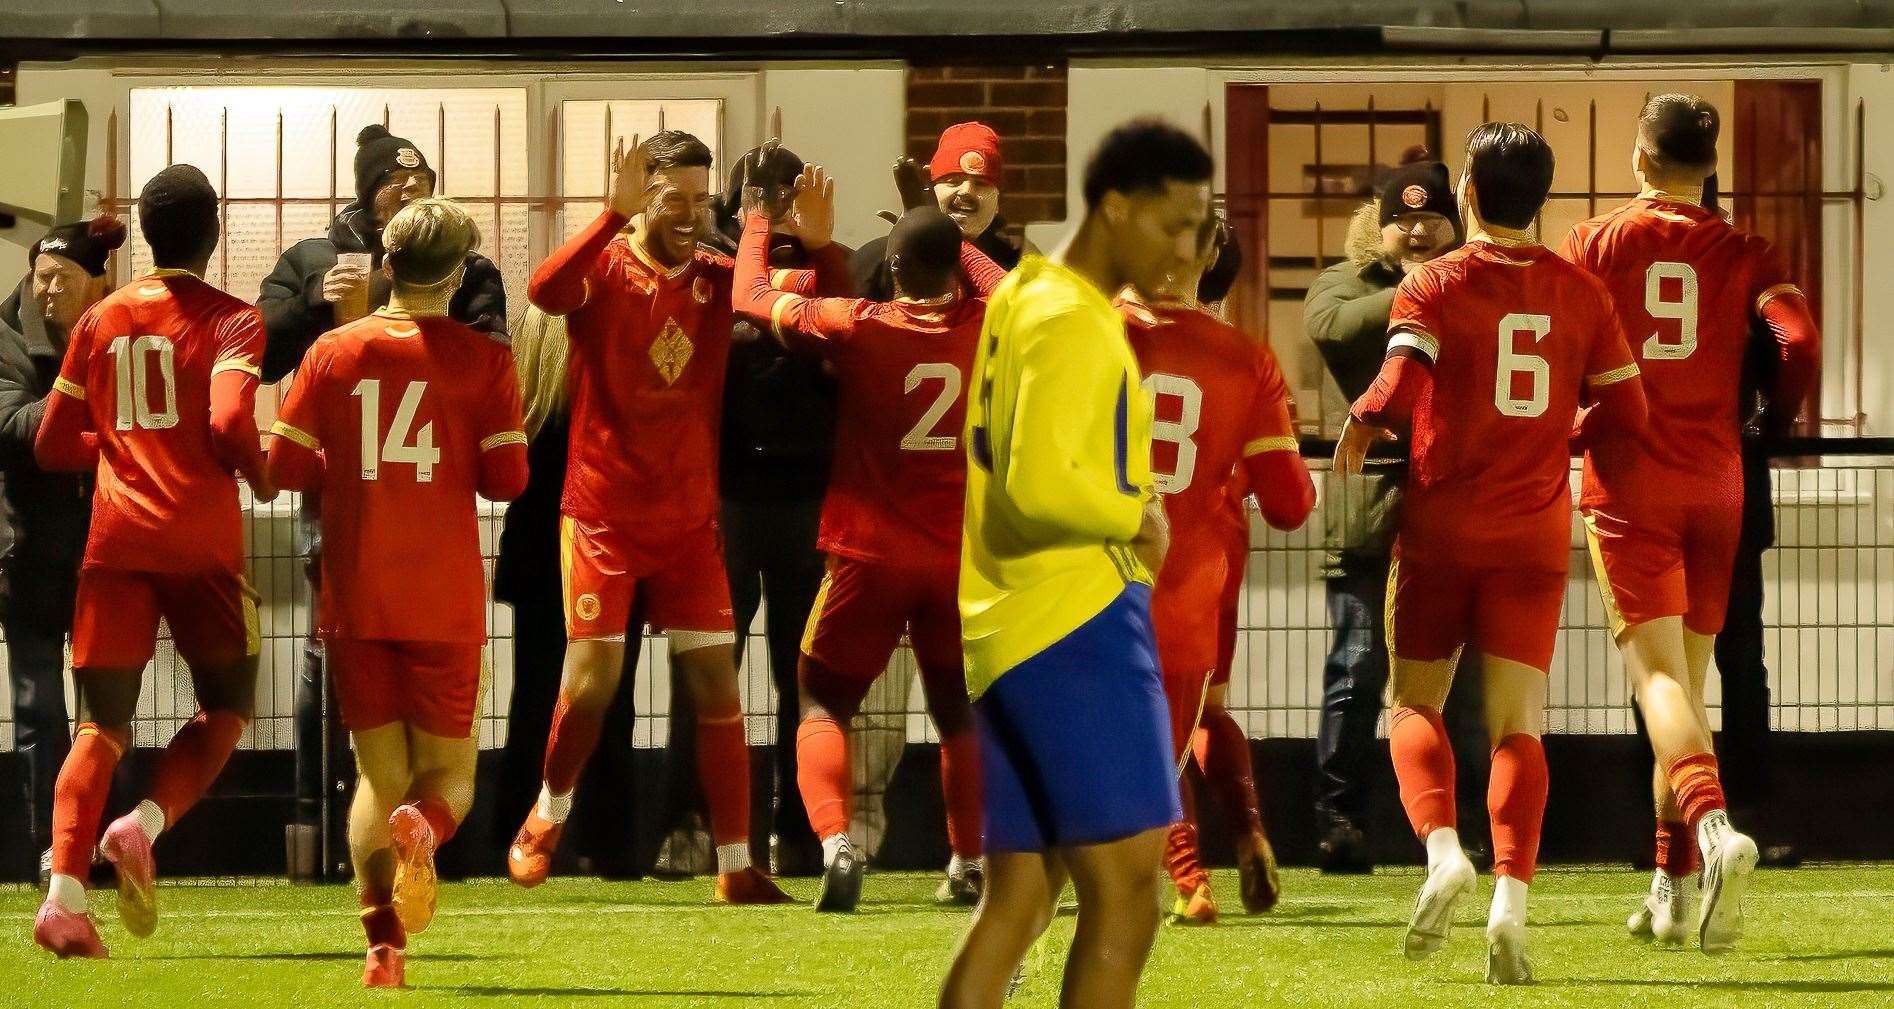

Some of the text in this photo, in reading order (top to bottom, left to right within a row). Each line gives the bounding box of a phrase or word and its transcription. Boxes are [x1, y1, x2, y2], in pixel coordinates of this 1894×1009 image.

[1643, 262, 1697, 359] 9
[107, 336, 179, 430] 10
[901, 363, 961, 450] 2
[1495, 313, 1551, 417] 6
[350, 379, 440, 482] 14
[1140, 373, 1203, 494] 8
